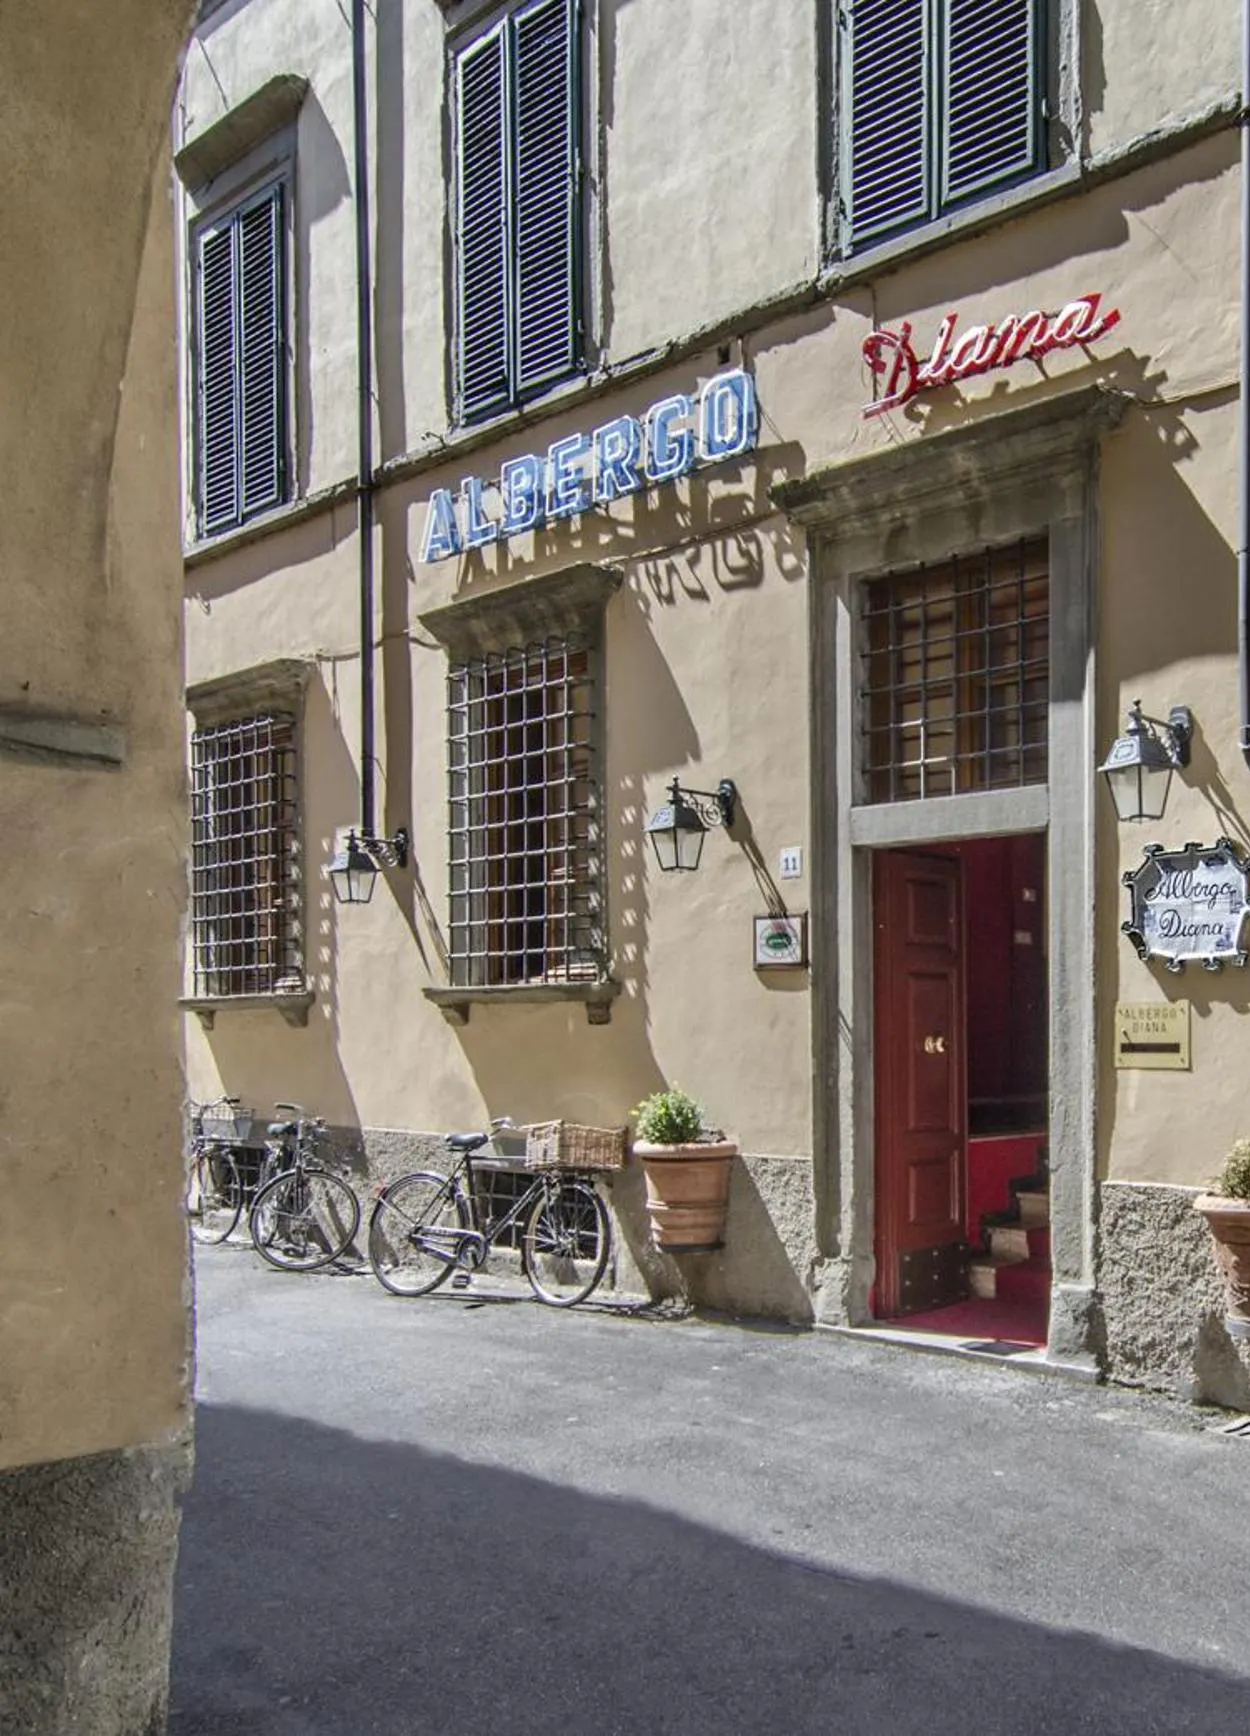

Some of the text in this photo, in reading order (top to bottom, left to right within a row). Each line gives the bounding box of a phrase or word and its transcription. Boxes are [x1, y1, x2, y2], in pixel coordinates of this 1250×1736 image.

[861, 292, 1121, 420] Diana
[418, 368, 760, 564] ALBERGO
[784, 856, 797, 871] 11
[1144, 870, 1236, 910] Albergo
[1159, 908, 1223, 938] Diana
[1124, 1007, 1177, 1020] ALBERGO
[1132, 1021, 1167, 1033] DIANA
